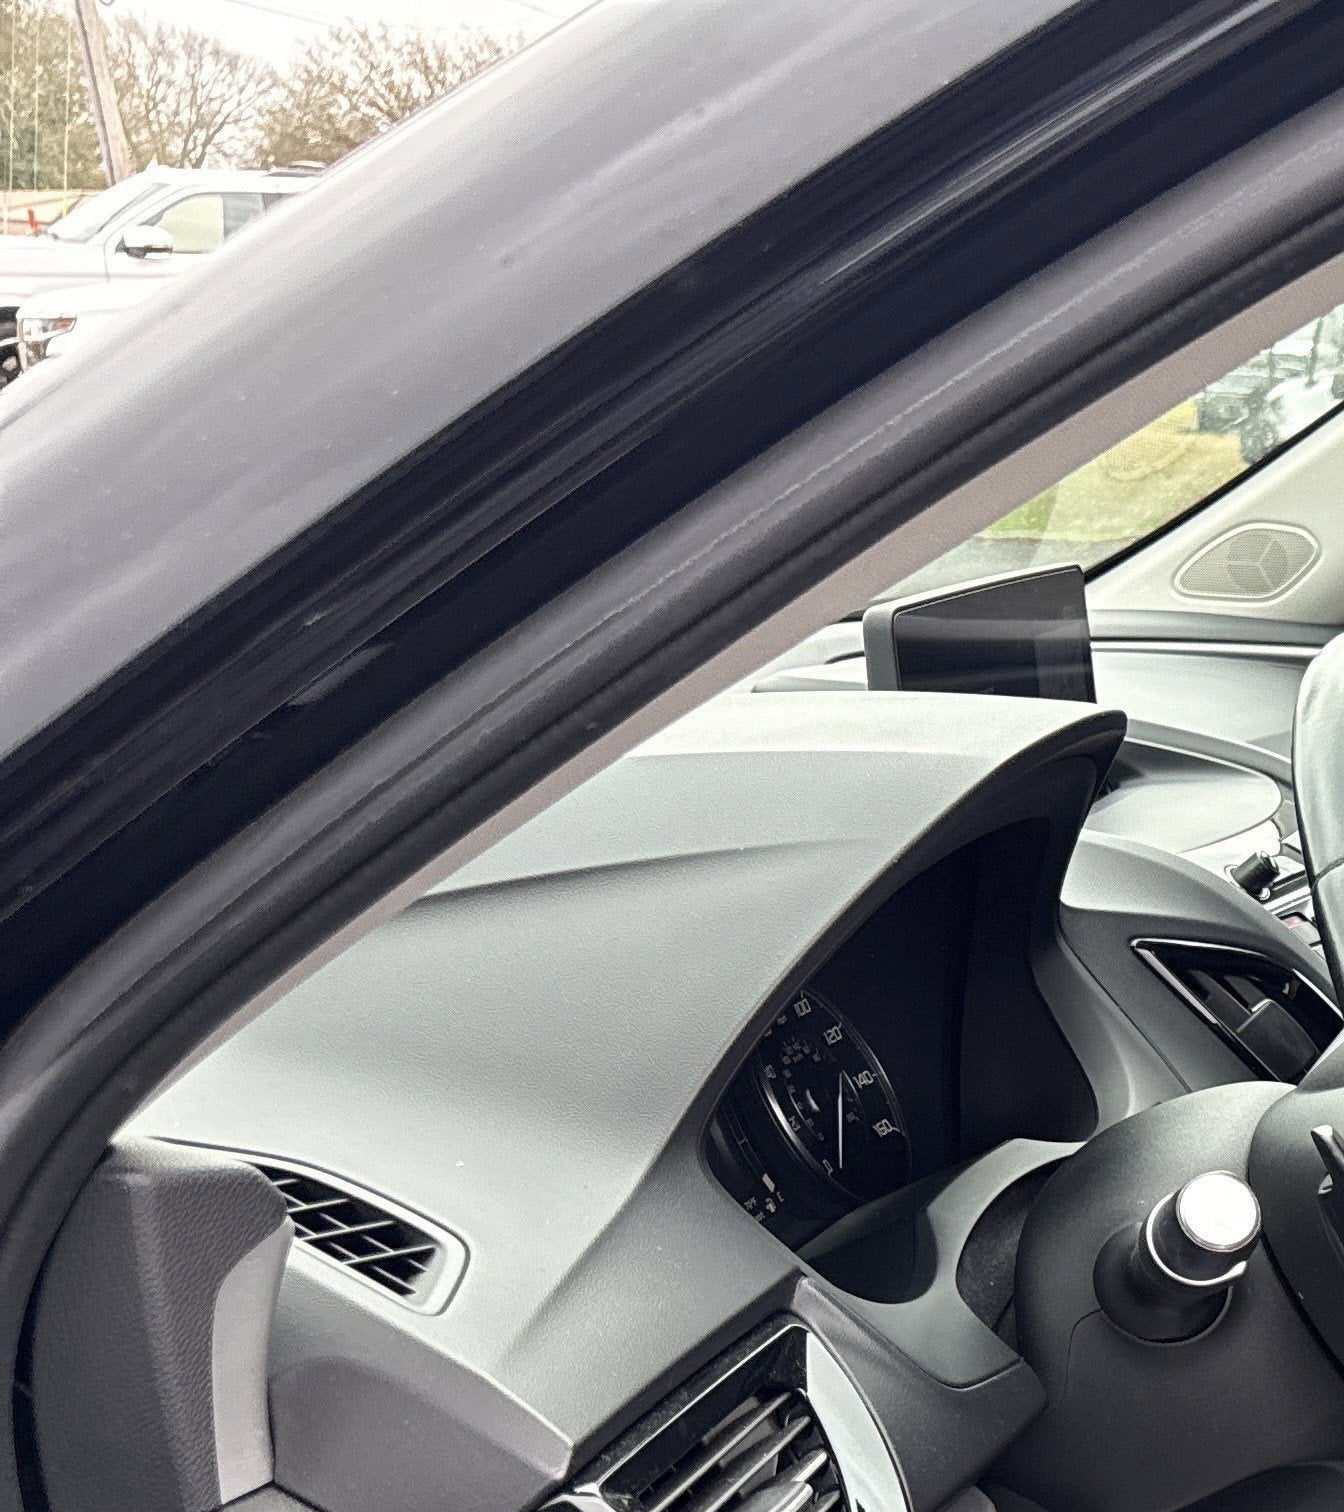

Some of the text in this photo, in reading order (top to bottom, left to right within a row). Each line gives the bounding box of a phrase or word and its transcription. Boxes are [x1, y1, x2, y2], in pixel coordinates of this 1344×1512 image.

[822, 1027, 843, 1045] 120
[853, 1069, 873, 1089] 140
[872, 1118, 893, 1137] 160
